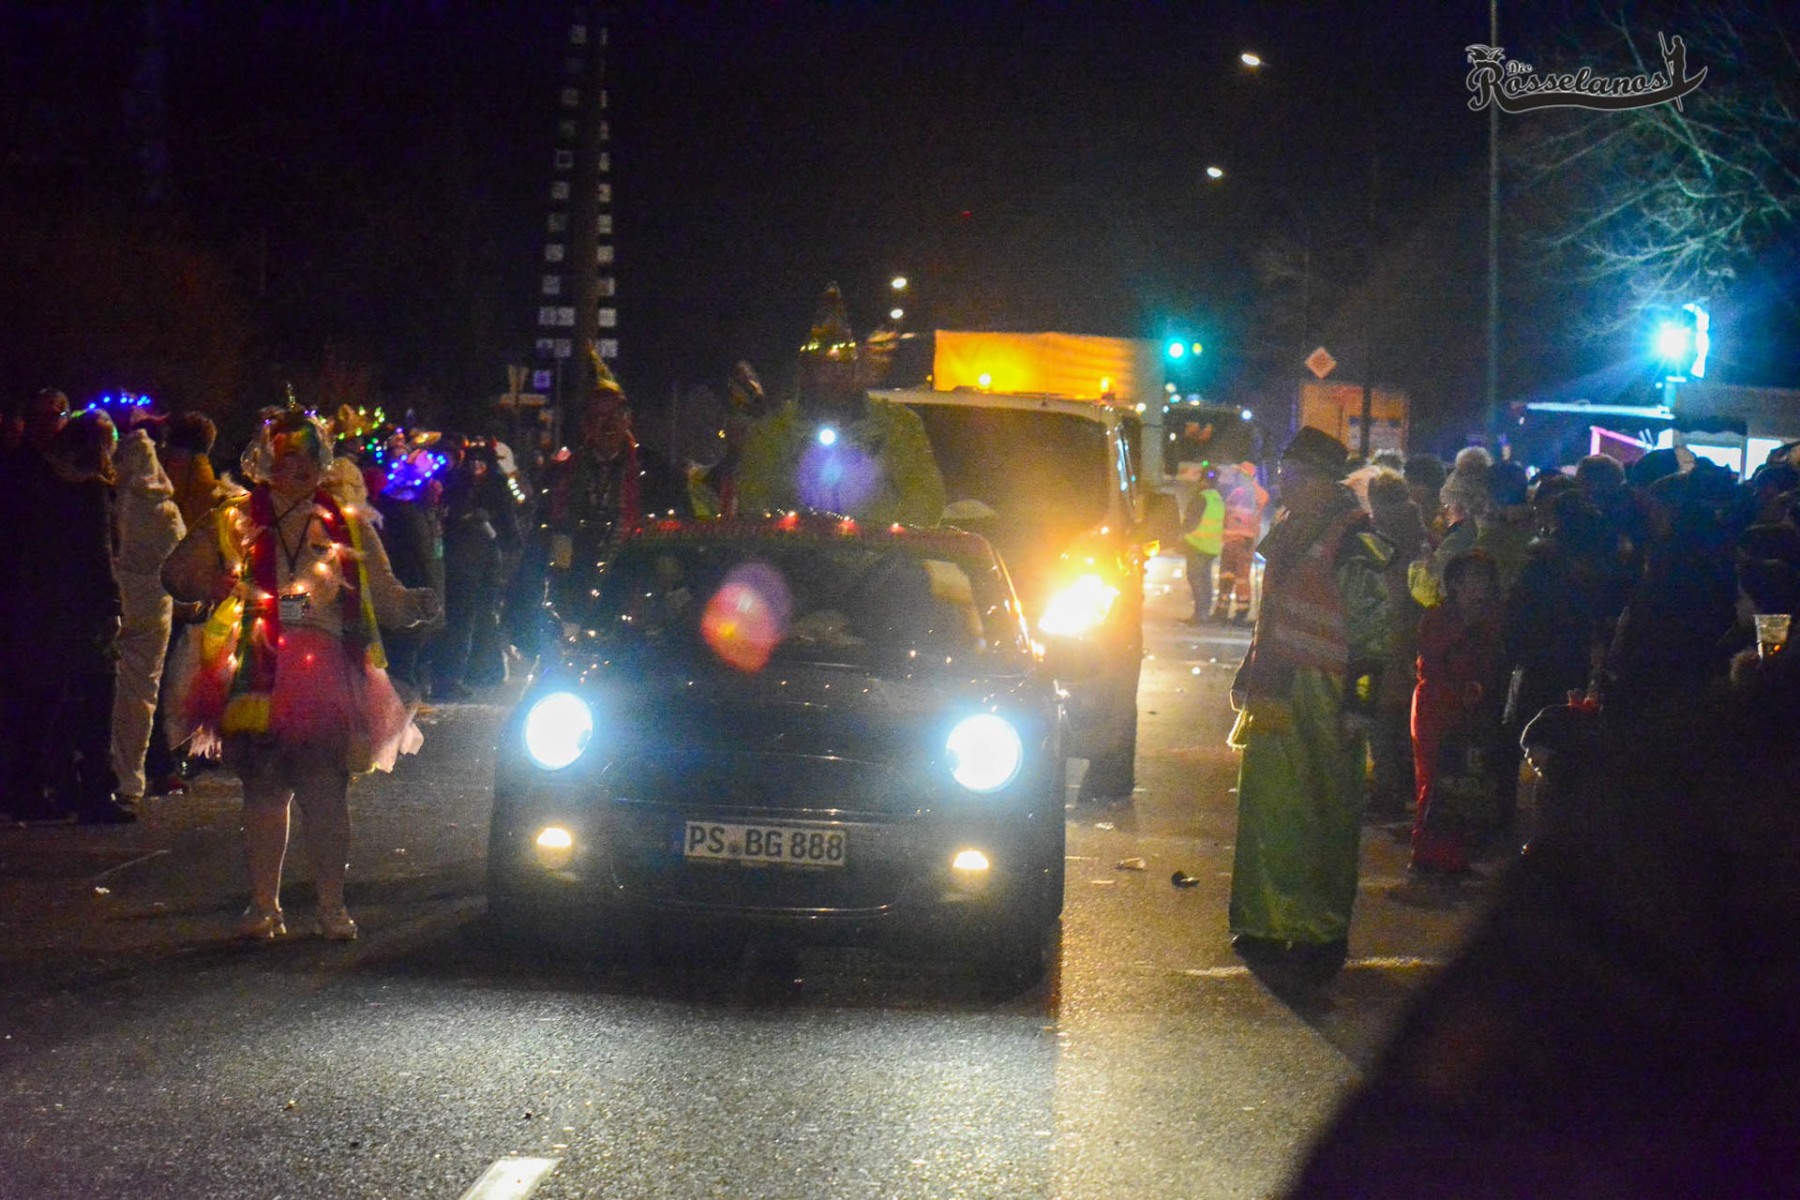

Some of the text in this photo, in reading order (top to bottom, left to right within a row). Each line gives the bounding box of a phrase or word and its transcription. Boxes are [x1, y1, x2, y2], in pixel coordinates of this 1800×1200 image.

[689, 826, 844, 861] PS BG 888
